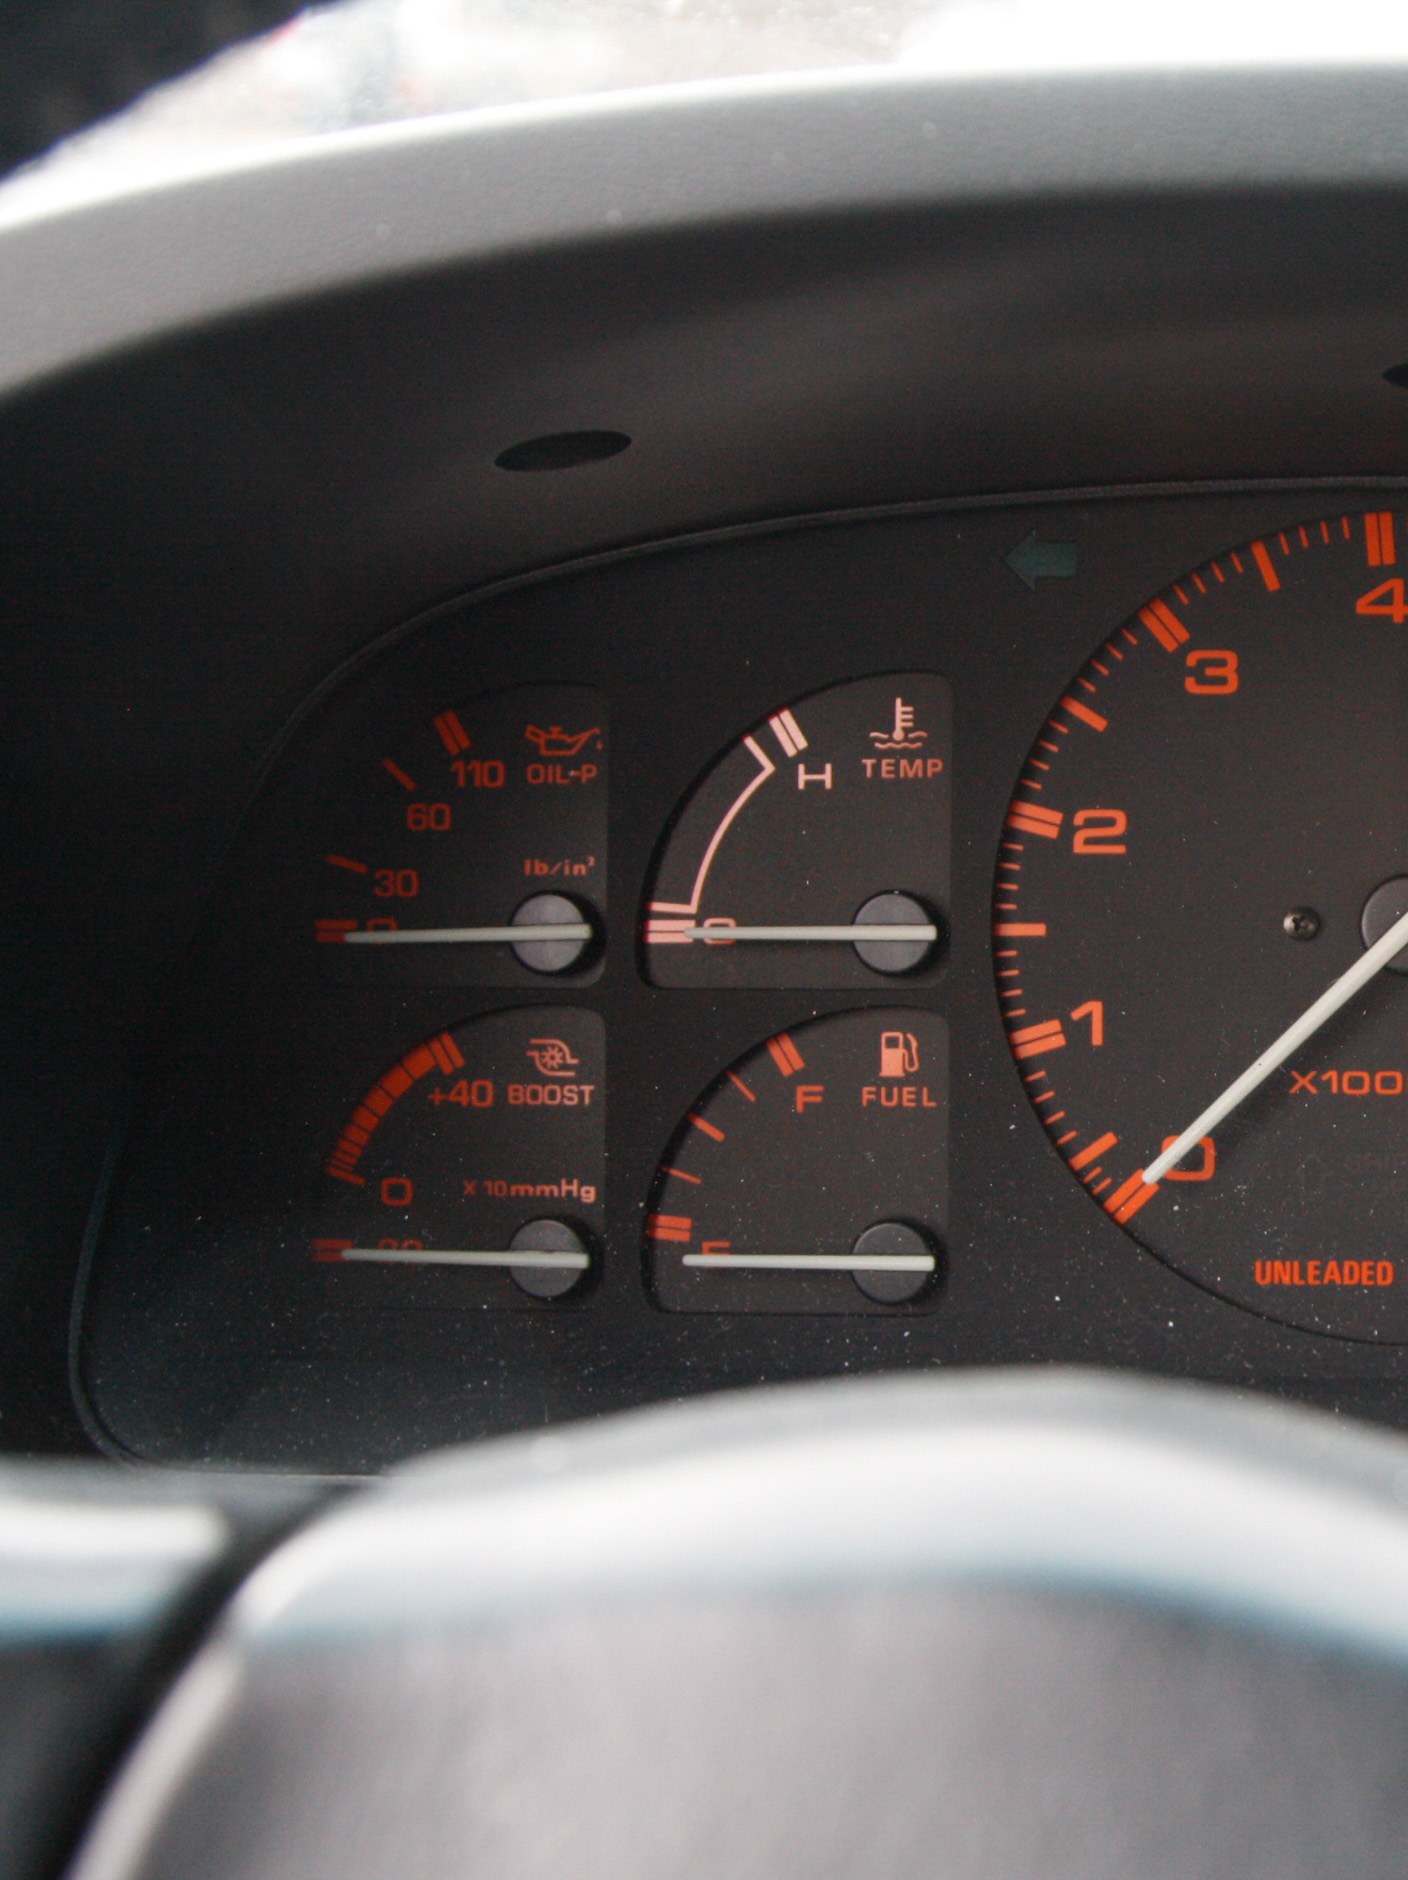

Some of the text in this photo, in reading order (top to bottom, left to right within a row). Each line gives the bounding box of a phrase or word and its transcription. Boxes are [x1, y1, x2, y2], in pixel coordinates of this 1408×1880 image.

[1185, 650, 1239, 694] 3
[453, 760, 505, 788] 110
[527, 764, 597, 784] OIL-P
[797, 763, 834, 790] H
[863, 758, 943, 778] TEMP
[408, 803, 451, 830] 60
[1073, 809, 1127, 854] 2
[375, 870, 419, 897] 30
[1070, 1001, 1104, 1046] 1
[430, 1080, 493, 1107] +40
[508, 1084, 593, 1104] BOOST
[796, 1086, 824, 1112] F
[862, 1087, 936, 1107] FUEL
[382, 1178, 413, 1206] 0
[1255, 1261, 1394, 1285] UNLEADED
